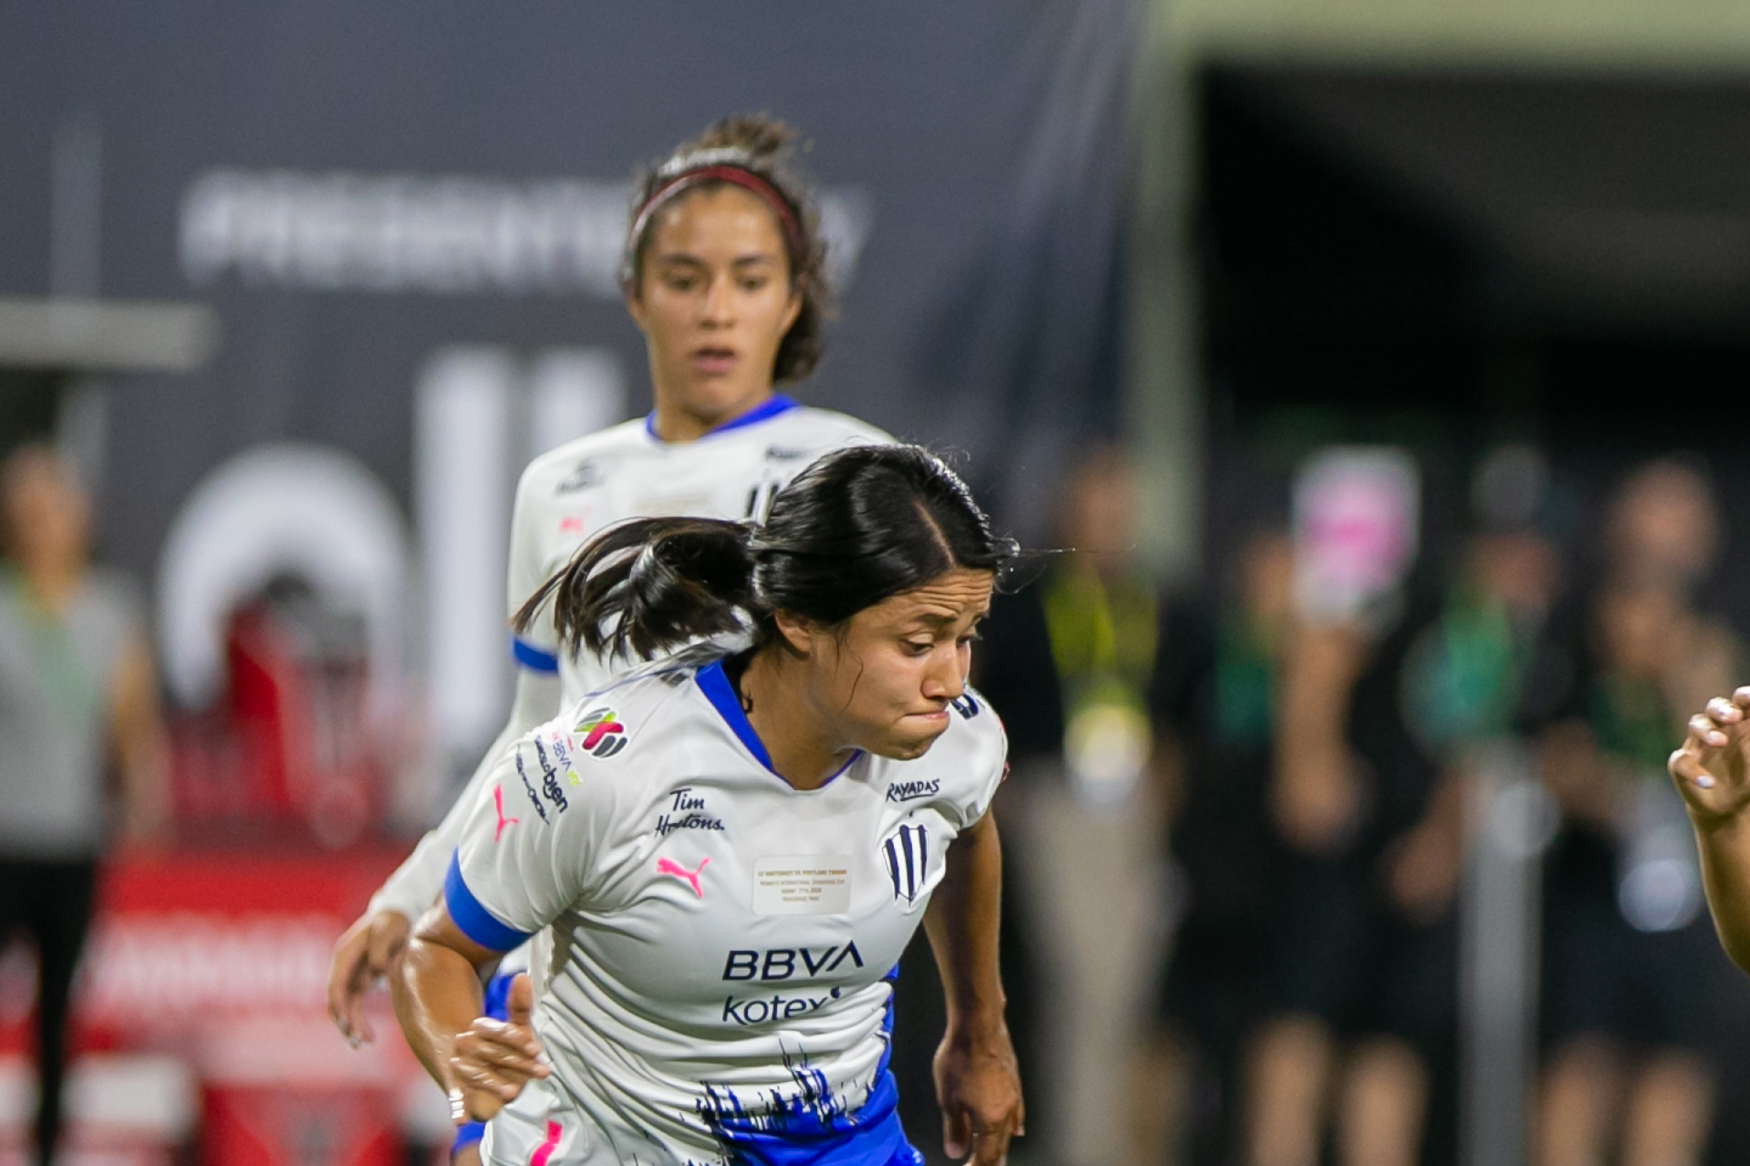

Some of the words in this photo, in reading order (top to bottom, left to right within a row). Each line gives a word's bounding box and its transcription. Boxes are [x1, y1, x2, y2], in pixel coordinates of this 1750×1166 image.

[669, 788, 704, 811] Tim
[886, 779, 940, 803] RAYADAS
[722, 940, 864, 980] BBVA
